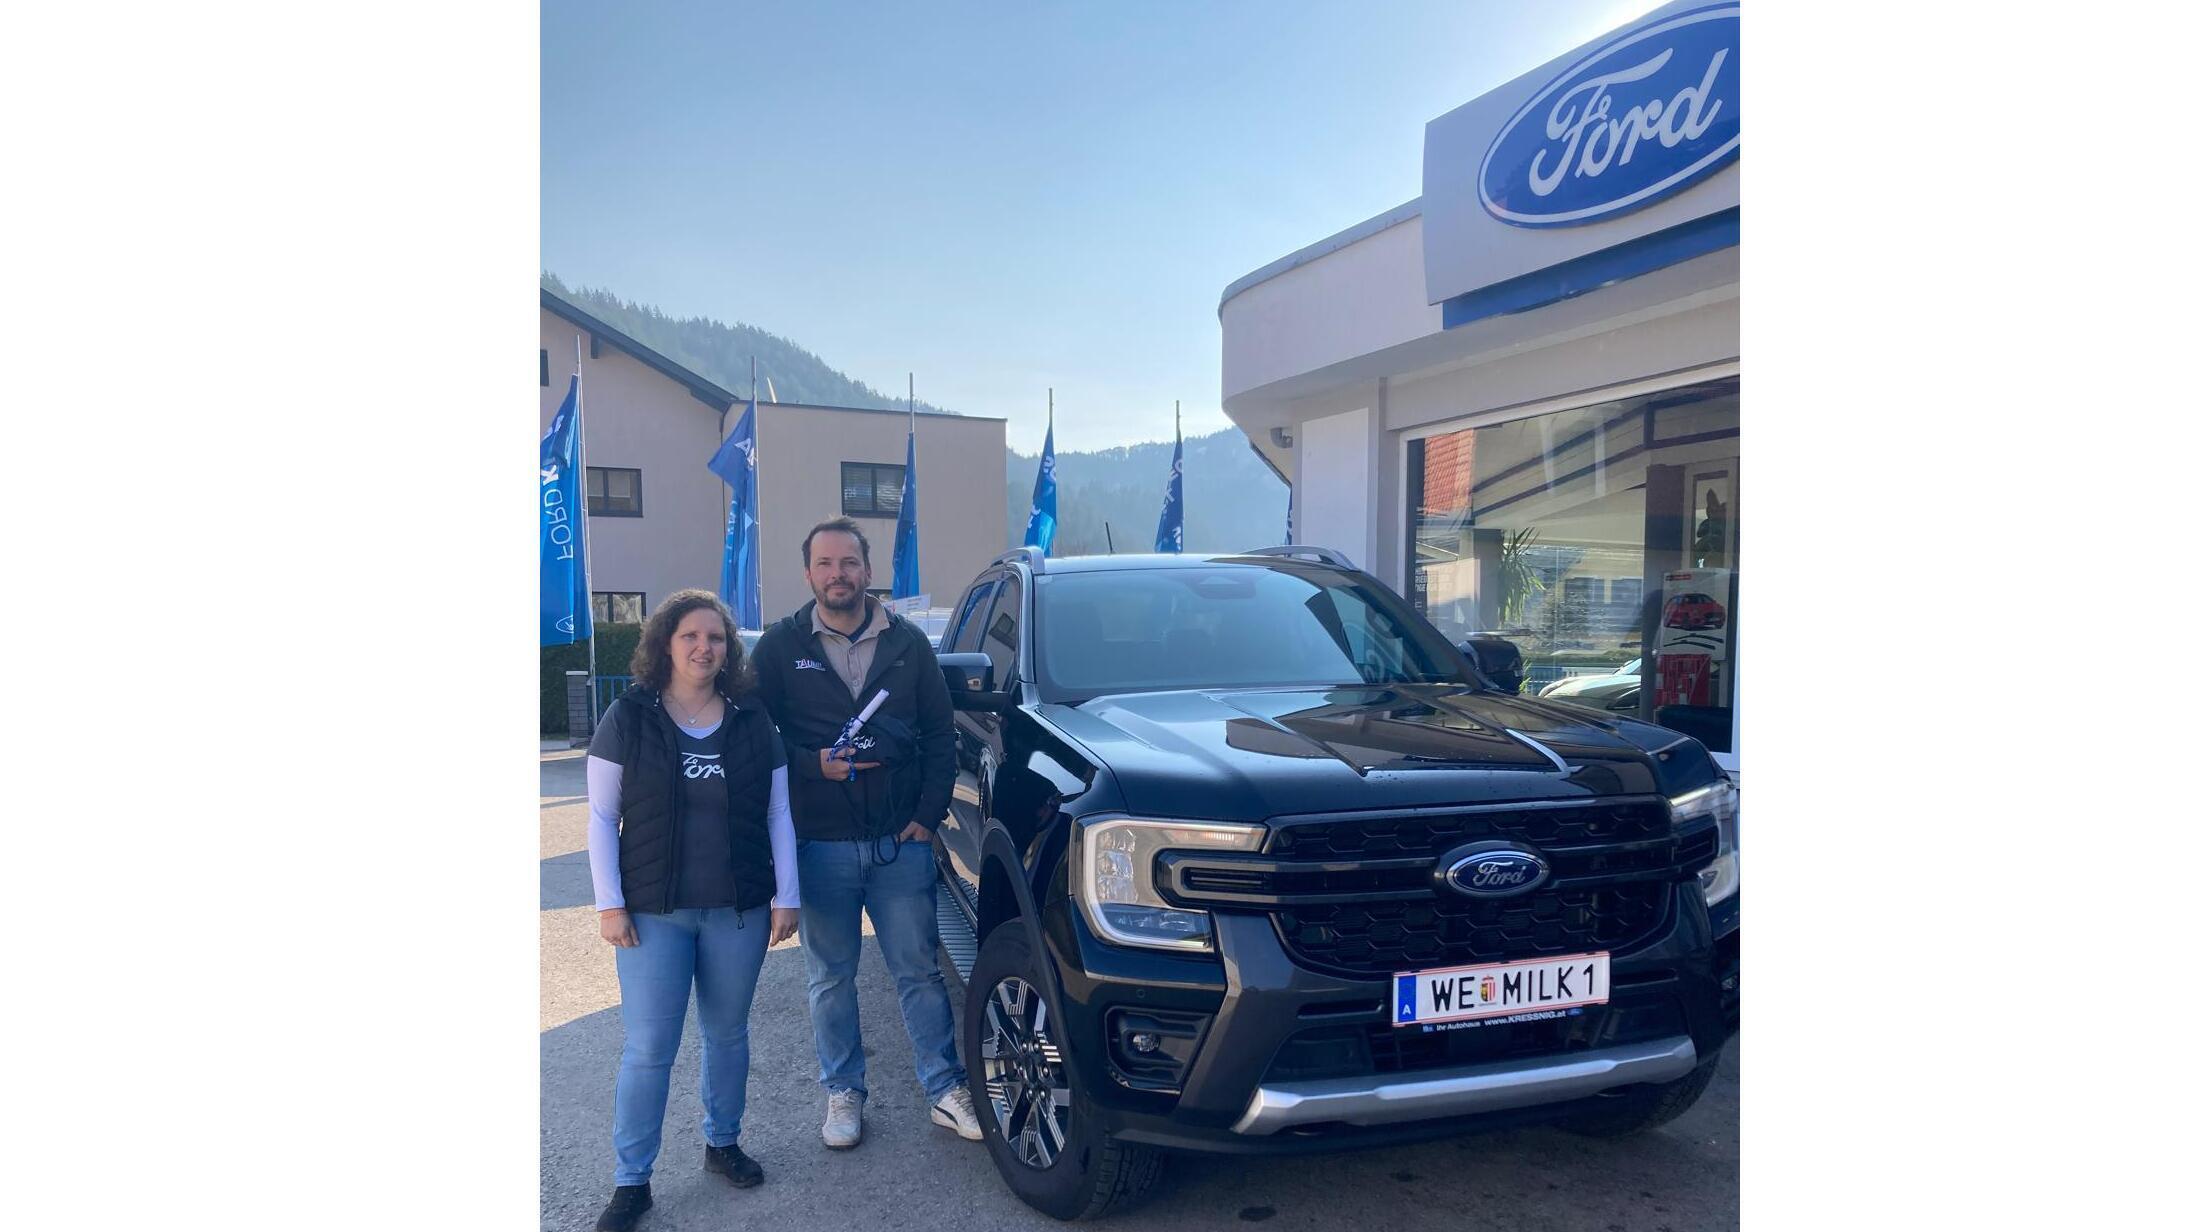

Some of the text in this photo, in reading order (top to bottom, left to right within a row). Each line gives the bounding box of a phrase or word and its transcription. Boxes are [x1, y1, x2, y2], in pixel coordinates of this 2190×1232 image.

[1528, 48, 1730, 197] Ford
[681, 752, 725, 779] For
[1472, 860, 1527, 887] Ford
[1431, 963, 1594, 1013] WE MILK 1
[1401, 1003, 1412, 1015] A
[1484, 1010, 1567, 1026] www.KRESSNIG.at
